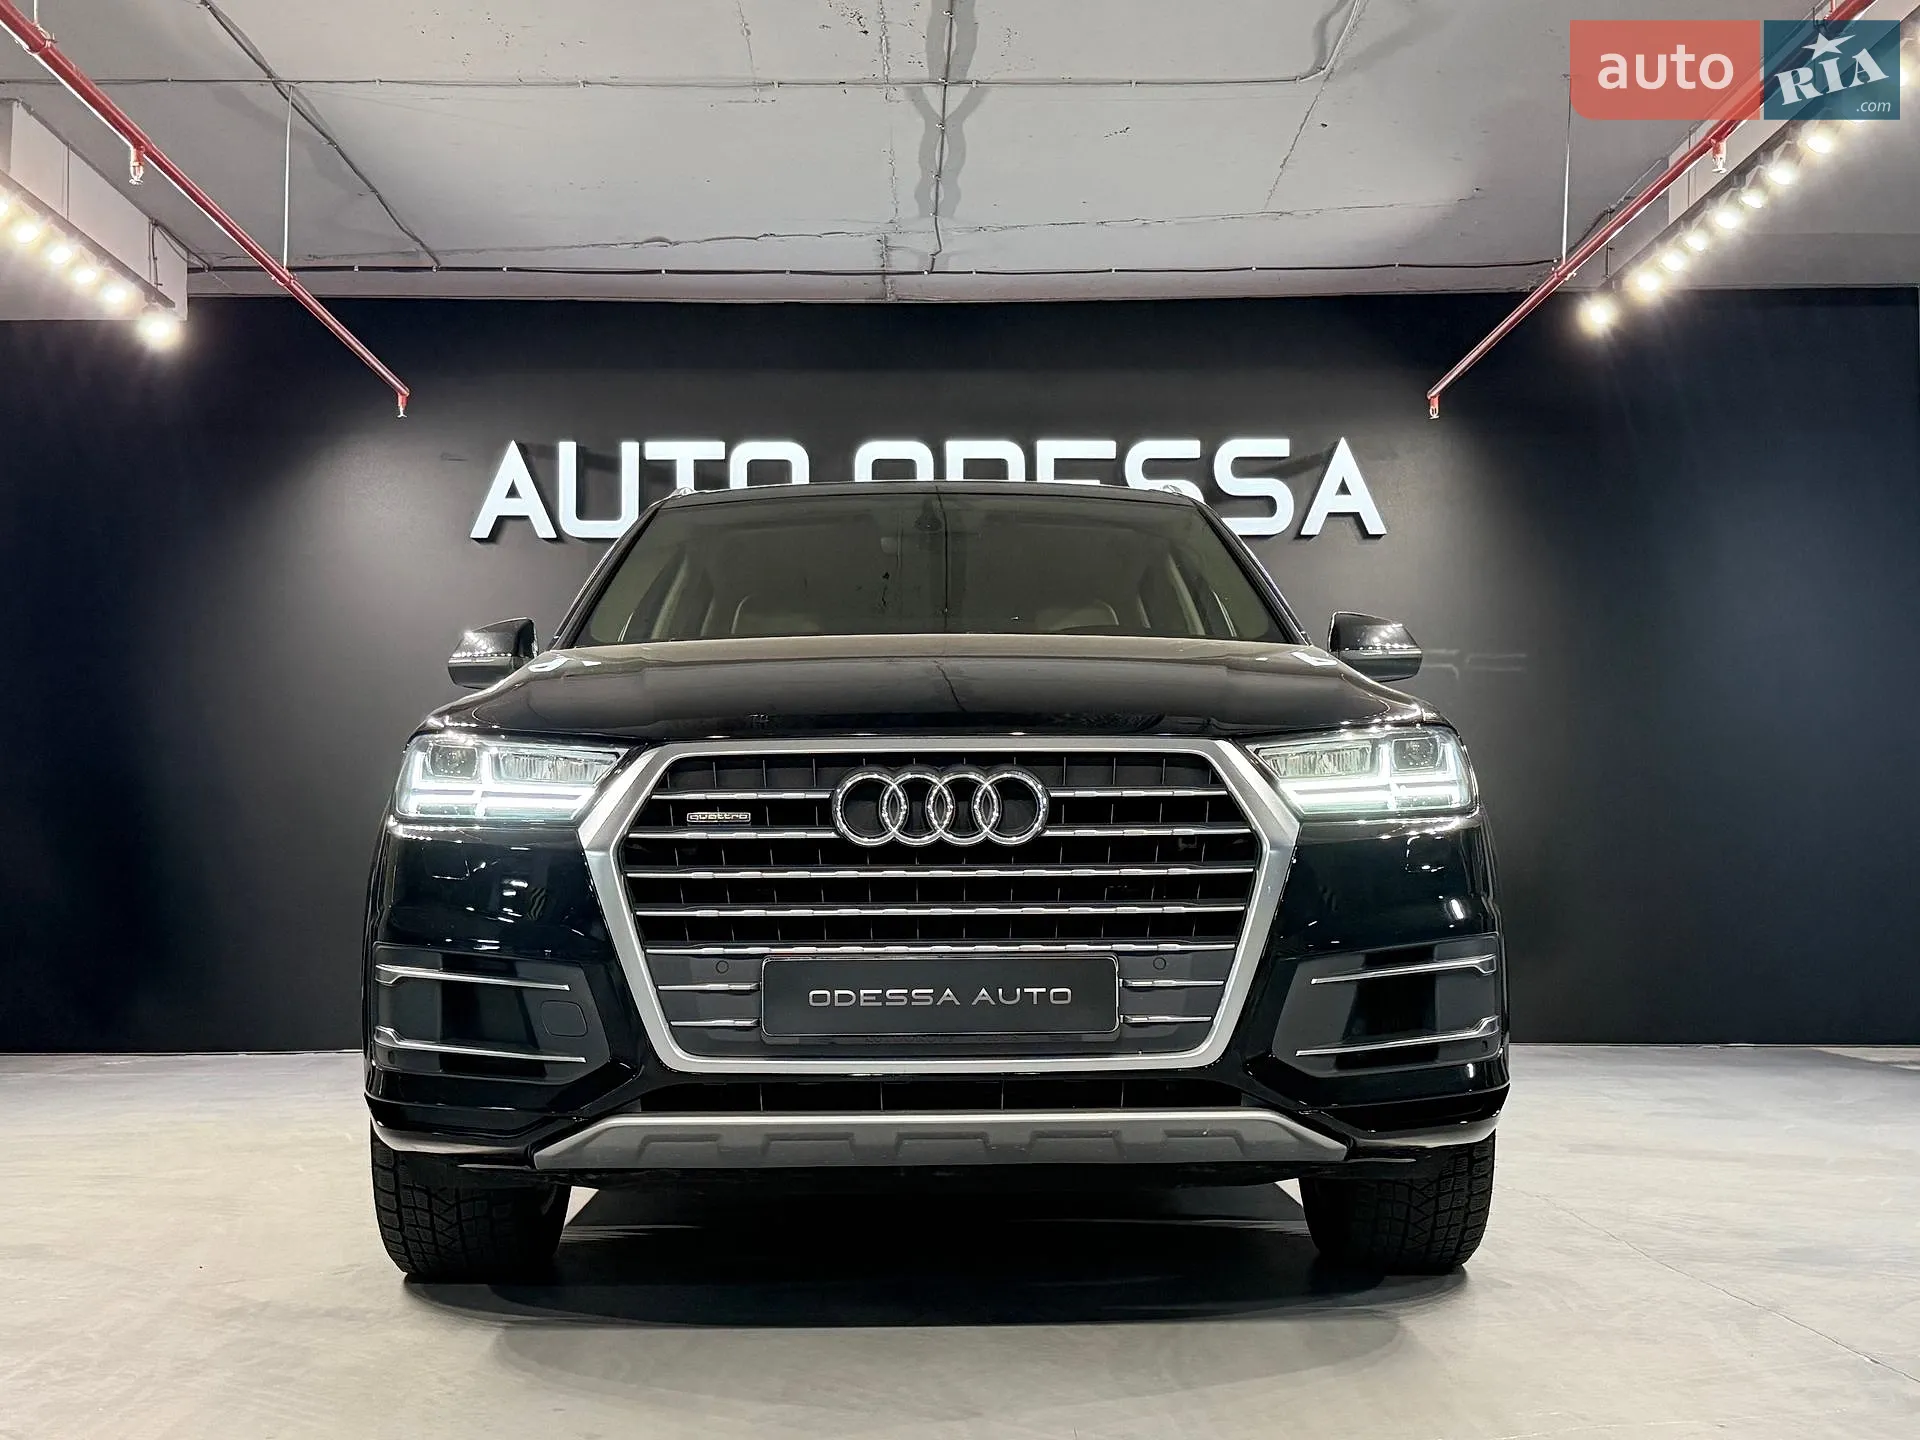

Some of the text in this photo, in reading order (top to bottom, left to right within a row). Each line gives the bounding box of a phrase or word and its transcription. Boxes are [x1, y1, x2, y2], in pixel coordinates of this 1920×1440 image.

[689, 813, 748, 821] quattro
[808, 987, 1072, 1007] ODESSA AUTO
